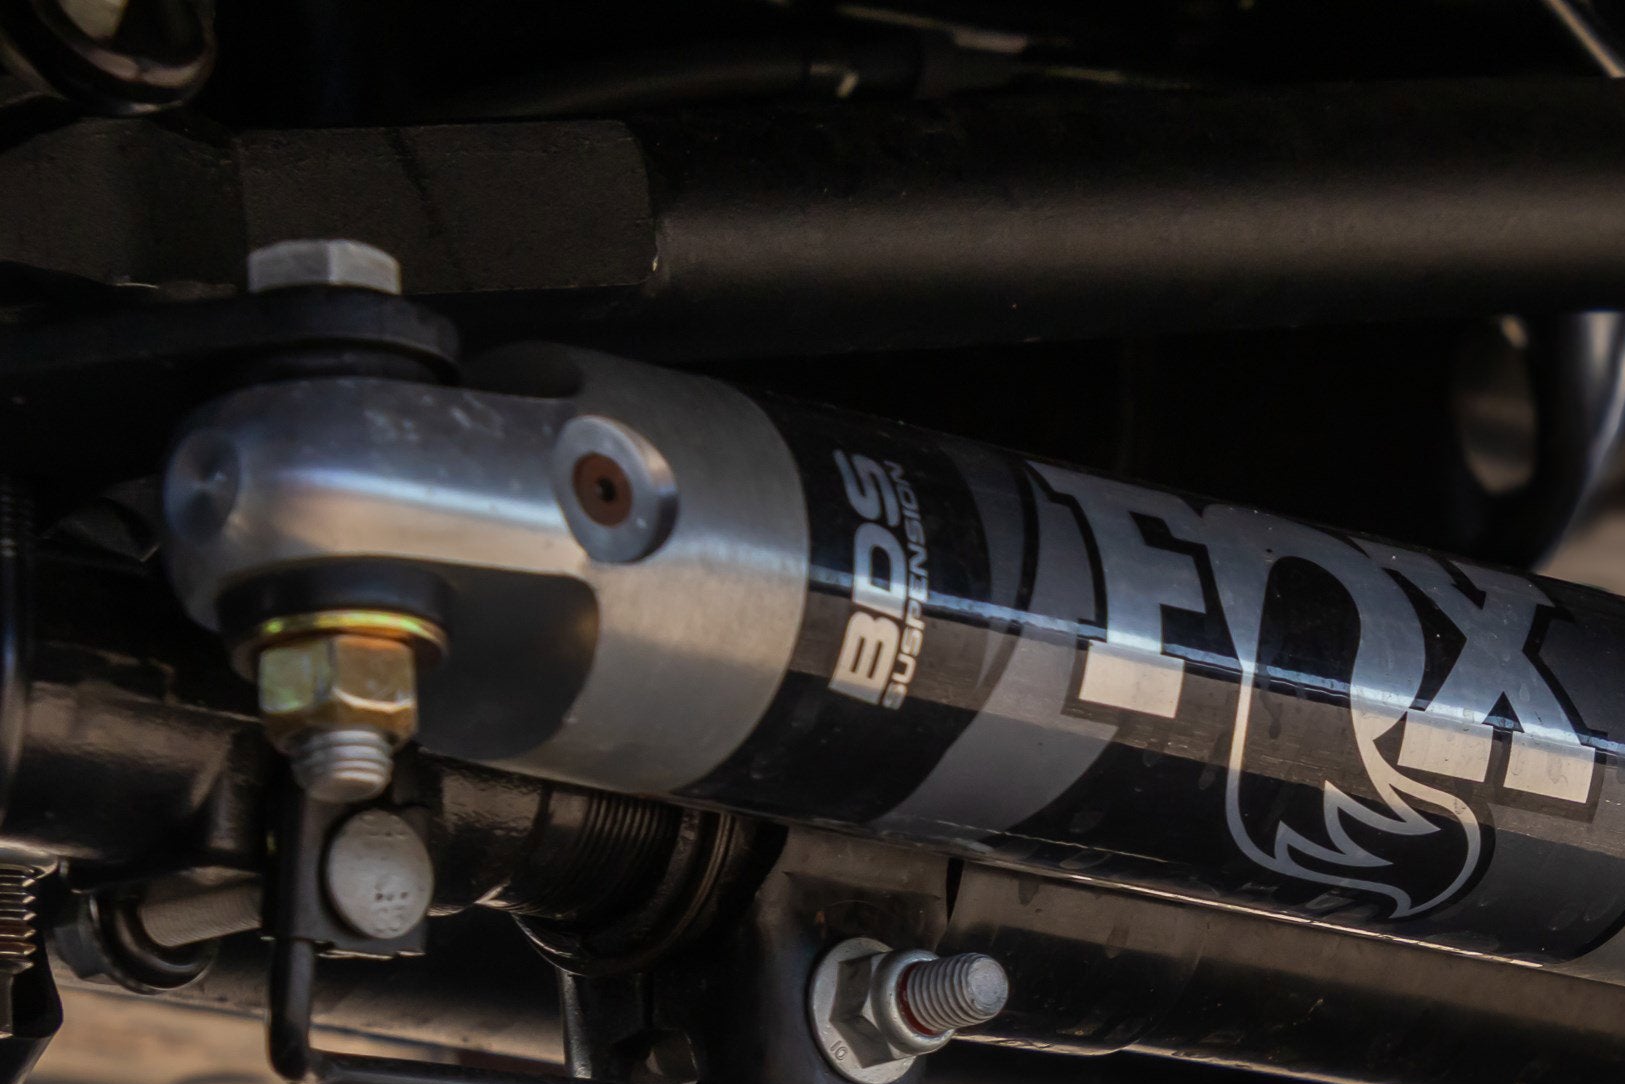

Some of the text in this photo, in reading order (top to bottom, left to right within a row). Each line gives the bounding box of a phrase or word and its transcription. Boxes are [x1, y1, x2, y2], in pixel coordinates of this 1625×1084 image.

[828, 449, 908, 705] BDS
[882, 459, 929, 710] SUSPENSION
[1026, 460, 1599, 917] FOX
